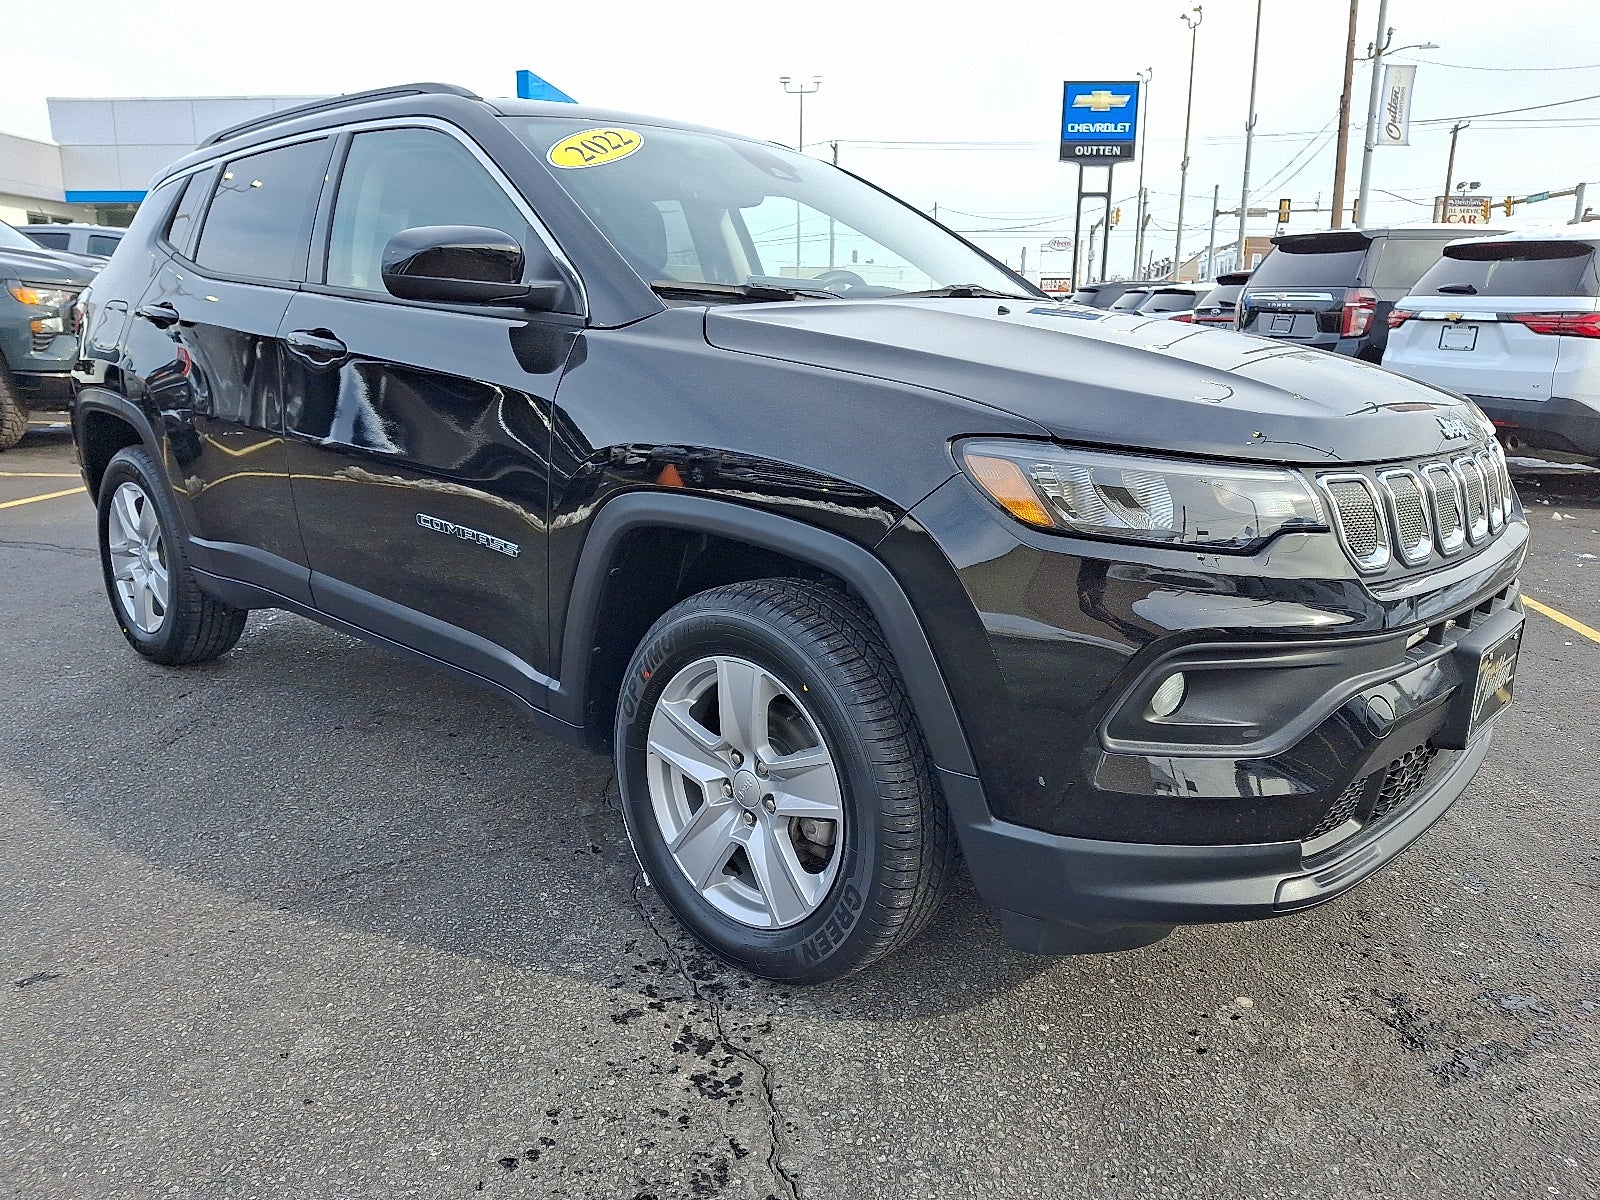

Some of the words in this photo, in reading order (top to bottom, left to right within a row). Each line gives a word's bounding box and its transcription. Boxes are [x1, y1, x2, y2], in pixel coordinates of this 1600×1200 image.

[1385, 86, 1401, 140] Outten
[1067, 122, 1131, 133] CHEVROLET
[564, 131, 633, 162] 2022
[1074, 145, 1121, 156] OUTTEN
[1447, 214, 1476, 224] CAR
[1436, 416, 1470, 440] Jeep
[415, 513, 521, 558] COMPASS
[1474, 652, 1516, 722] Outten
[738, 777, 753, 800] Jeep
[802, 884, 862, 961] GREEN
